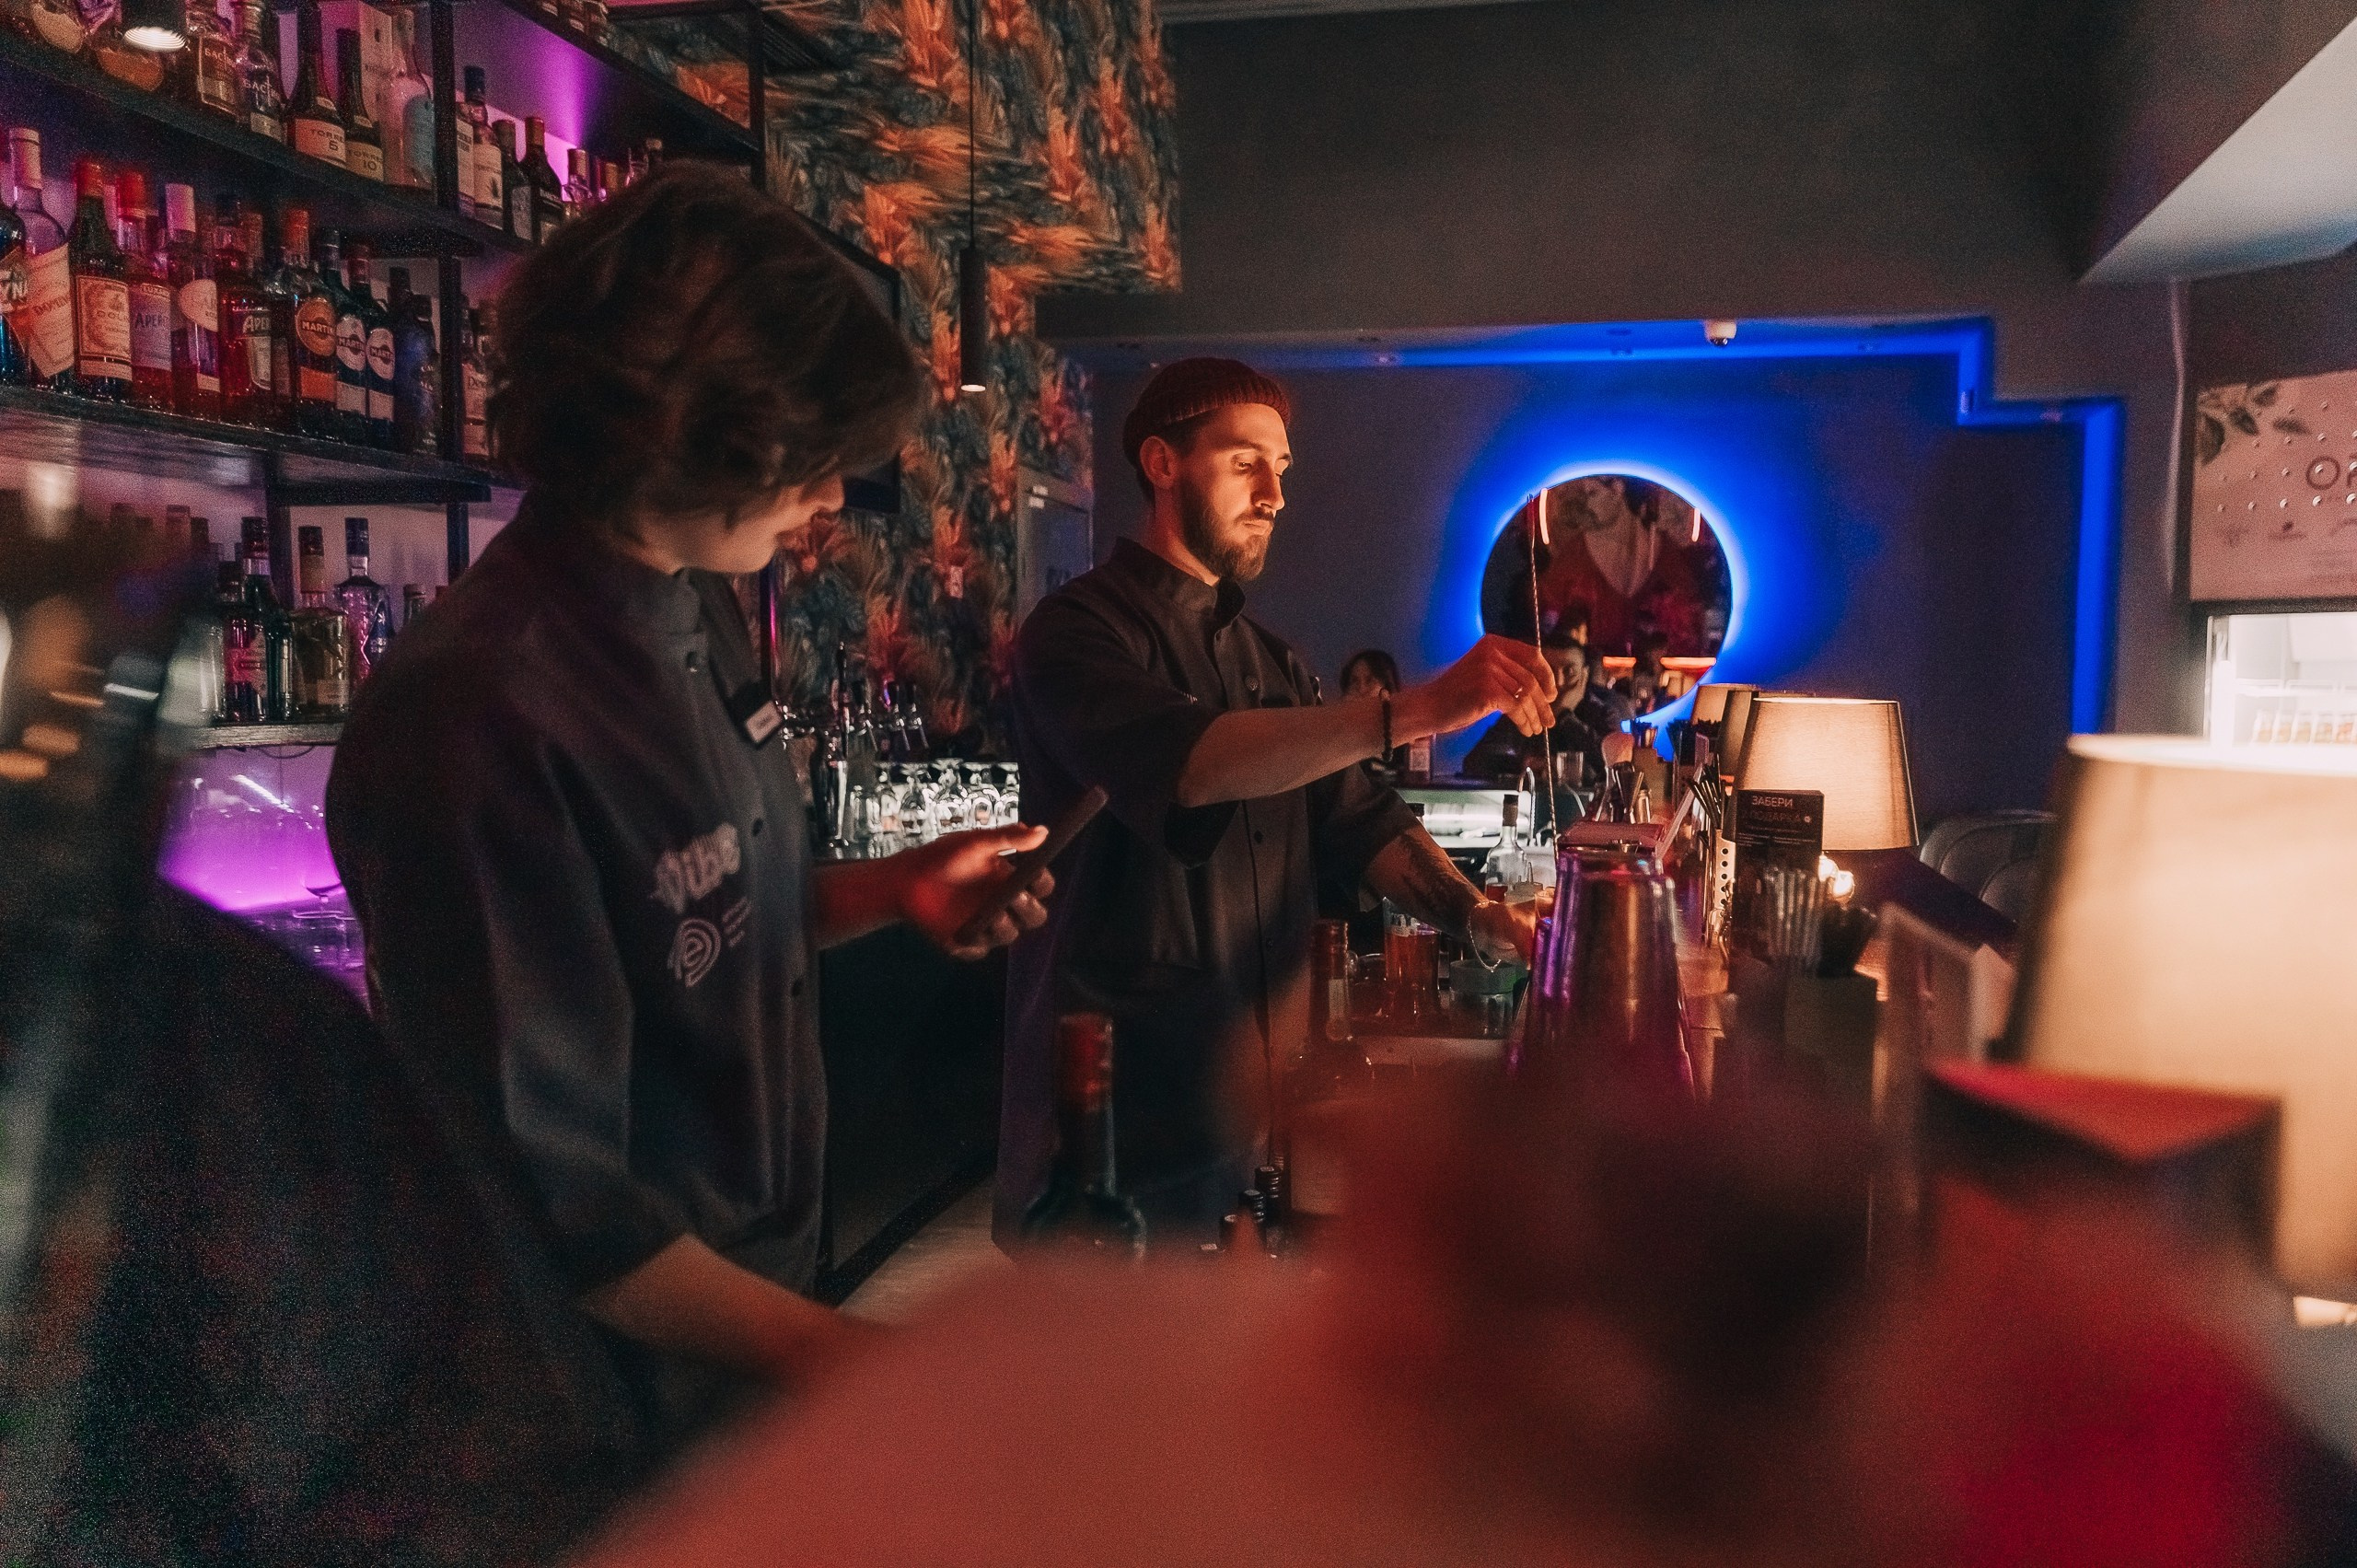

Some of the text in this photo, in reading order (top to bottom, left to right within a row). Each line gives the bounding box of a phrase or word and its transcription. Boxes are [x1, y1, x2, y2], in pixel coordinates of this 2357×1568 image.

[328, 140, 339, 151] 5
[362, 159, 377, 171] 10
[1751, 796, 1794, 807] ЗАБЕРИ
